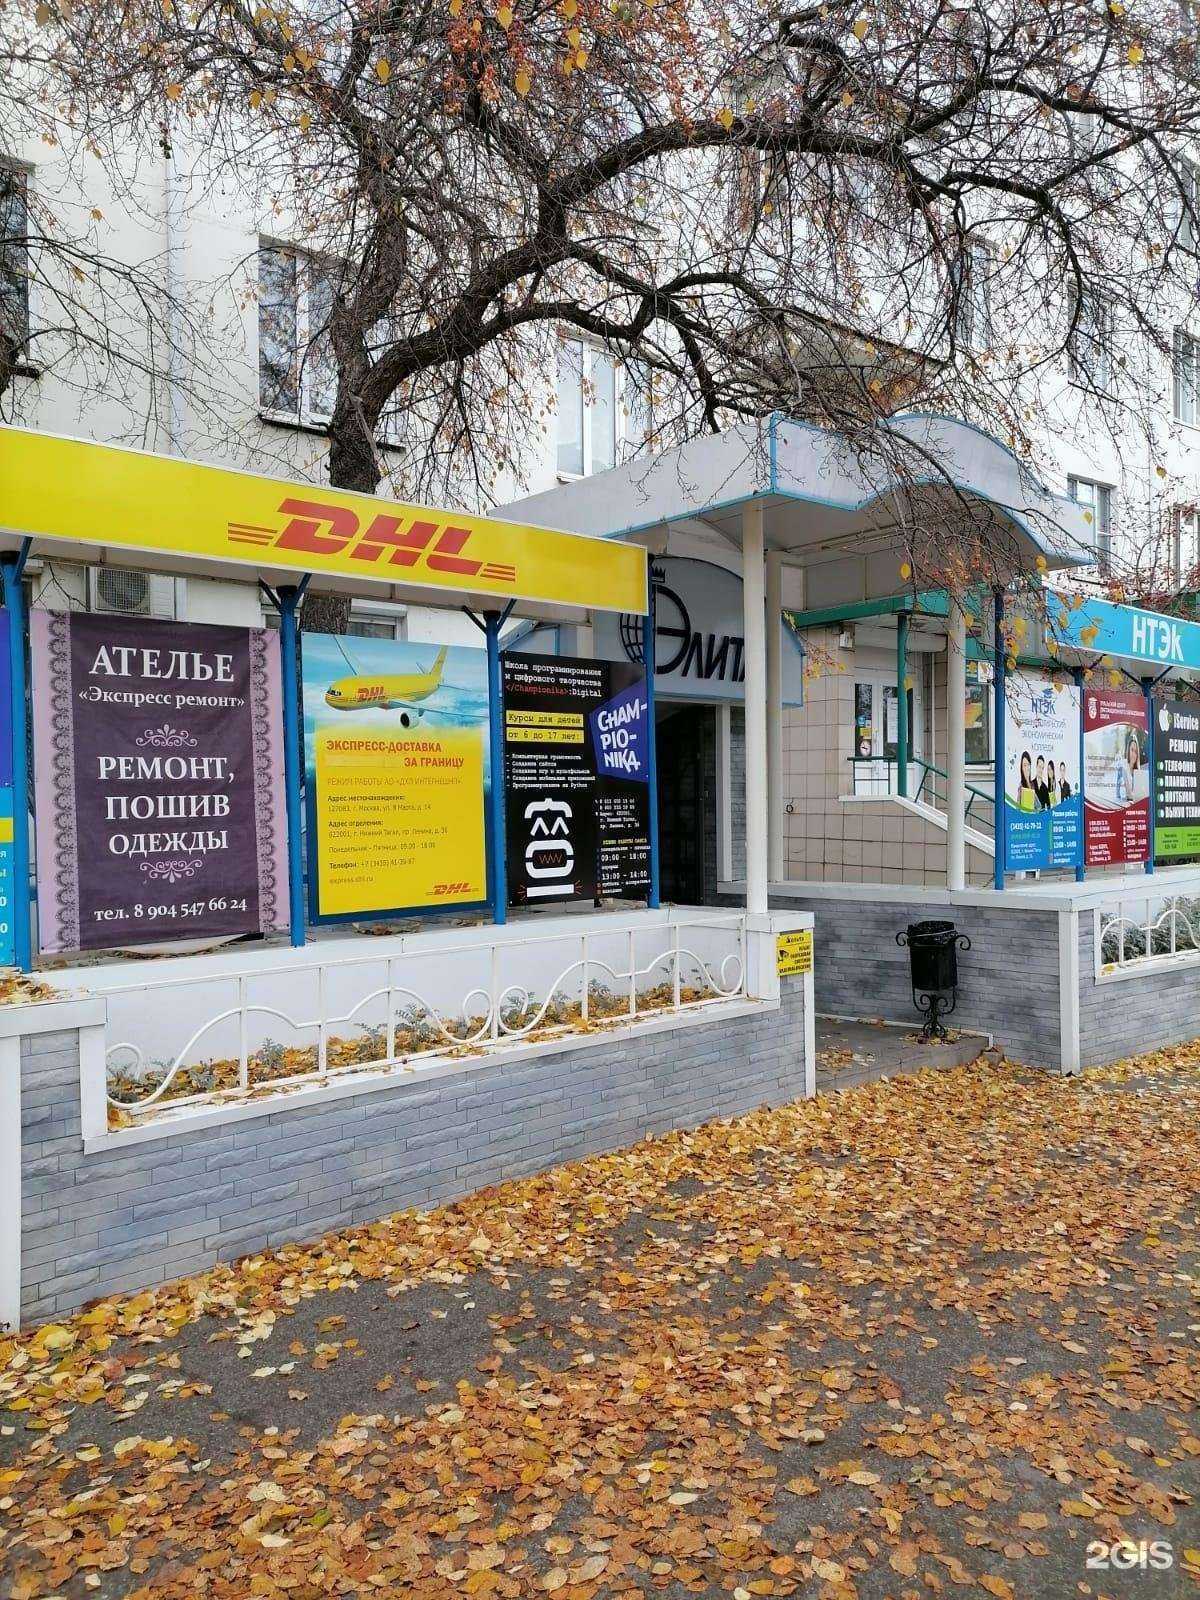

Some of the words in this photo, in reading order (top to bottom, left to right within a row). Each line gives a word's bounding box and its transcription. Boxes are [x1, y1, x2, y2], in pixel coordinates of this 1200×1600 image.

[274, 498, 483, 576] DHL
[1132, 615, 1184, 662] НТЭК
[89, 645, 235, 682] АТЕЛЬЕ
[505, 661, 529, 670] Школа
[532, 665, 602, 676] программирования
[514, 674, 556, 684] цифрового
[559, 677, 602, 687] творчества
[79, 686, 171, 707] «Экспресс
[176, 694, 245, 709] ремонт»
[508, 714, 534, 723] Курсы
[597, 698, 648, 731] CHAM-
[326, 740, 442, 753] ЭКСПРЕСС-ДОСТАВКА
[600, 728, 637, 750] PIO-
[1169, 739, 1197, 754] РЕМОНТ
[97, 756, 235, 783] РЕМОНТ,
[404, 757, 417, 767] ЗА
[421, 757, 464, 768] ГРАНИЦУ
[604, 748, 640, 773] NIKA
[104, 795, 231, 820] ПОШИВ
[109, 830, 229, 858] ОДЕЖДЫ
[94, 907, 130, 921] тел.
[134, 903, 143, 917] 8
[147, 905, 176, 921] 904
[180, 902, 205, 918] 547
[208, 898, 227, 912] 66
[230, 898, 247, 912] 24
